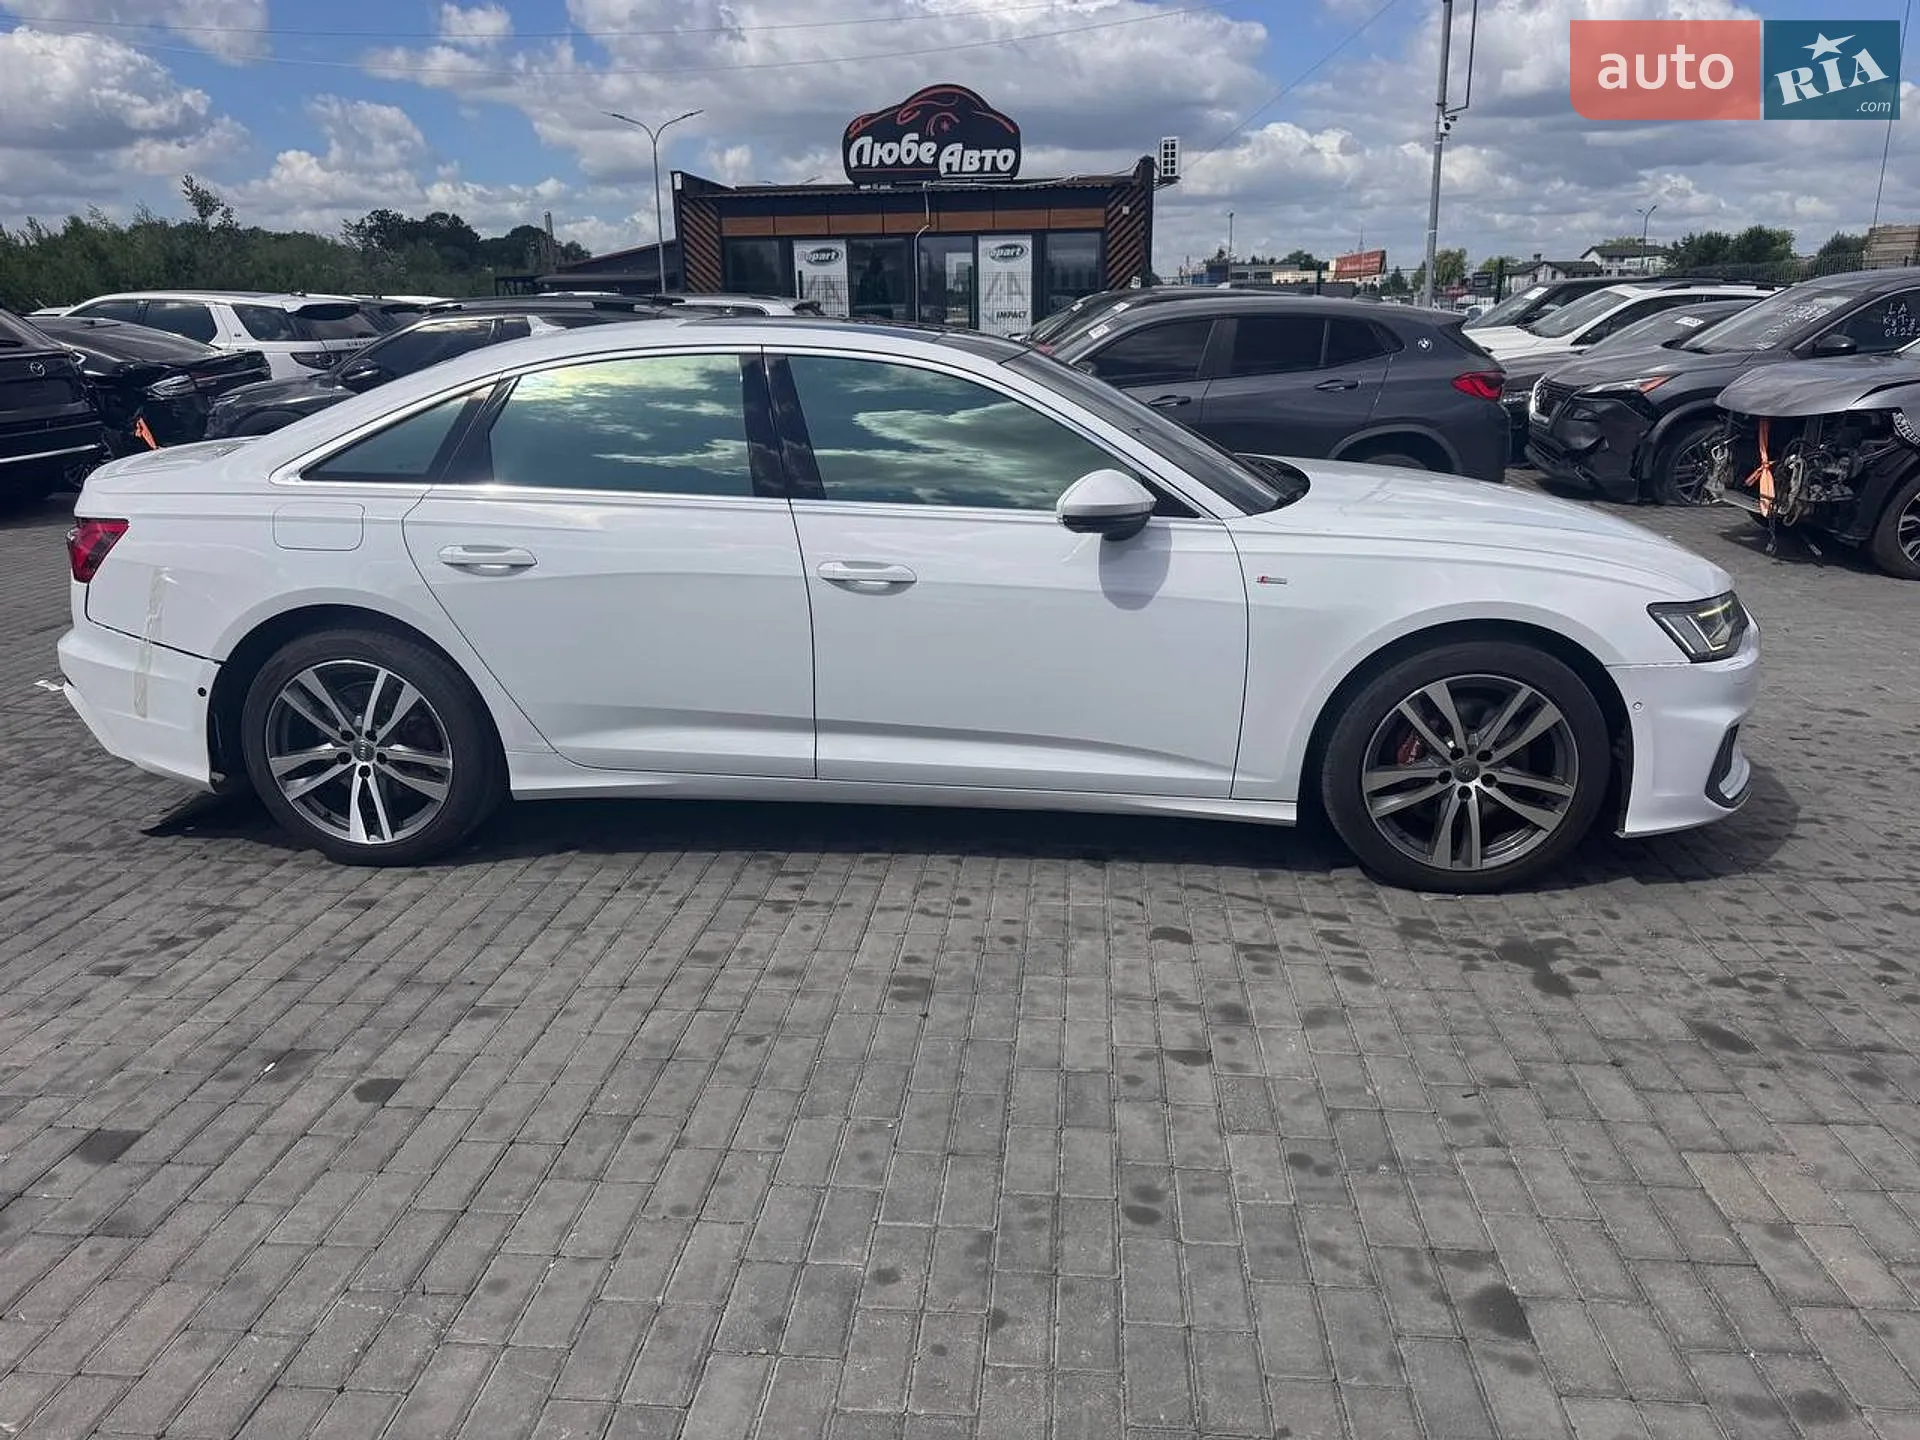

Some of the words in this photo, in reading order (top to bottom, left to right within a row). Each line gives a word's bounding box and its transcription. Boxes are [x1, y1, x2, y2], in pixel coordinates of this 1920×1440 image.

[849, 132, 938, 169] Любе
[938, 142, 1016, 177] Авто
[996, 311, 1027, 319] IMPACT
